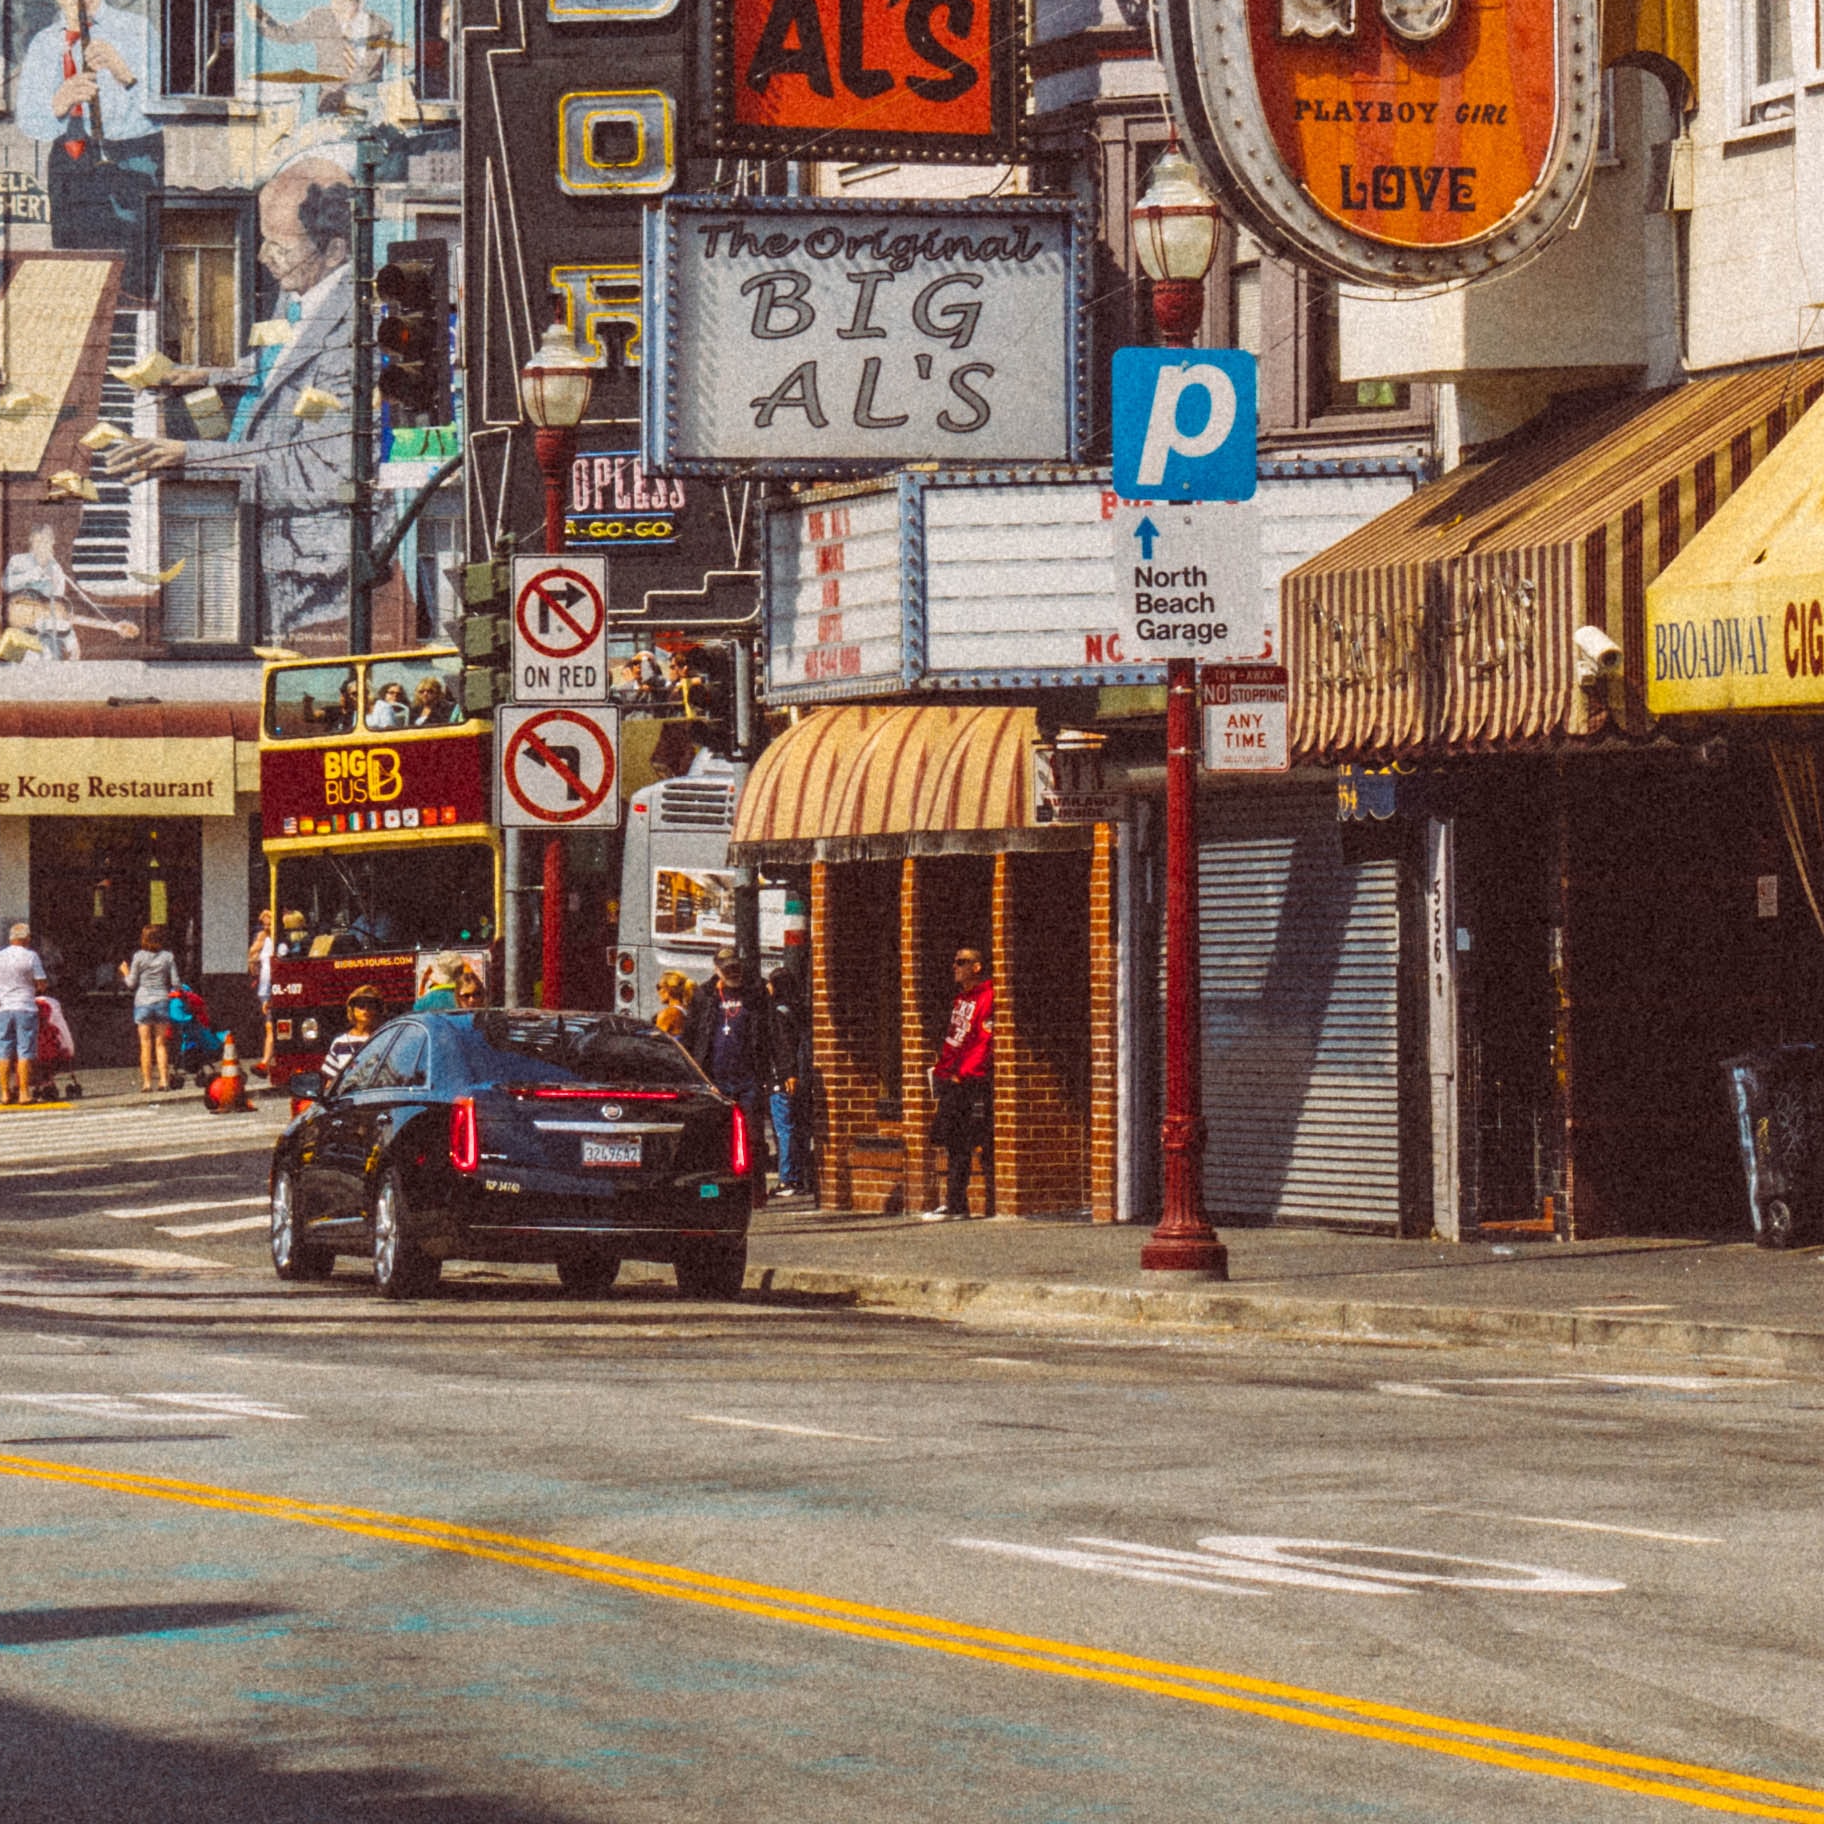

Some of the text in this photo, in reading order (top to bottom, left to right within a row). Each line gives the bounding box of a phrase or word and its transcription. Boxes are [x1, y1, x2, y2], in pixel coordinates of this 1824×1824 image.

[1294, 98, 1510, 126] PLAYBOY GIRL
[1339, 164, 1477, 213] LOVE
[698, 222, 1043, 270] The Original
[740, 269, 985, 350] BIG
[749, 354, 996, 434] AL'S
[572, 457, 686, 512] OPLESS
[1134, 565, 1208, 588] North
[1135, 591, 1215, 614] Beach
[1136, 618, 1228, 645] Garage
[1654, 614, 1772, 683] BROADWAY
[524, 665, 597, 689] ON RED
[1204, 683, 1286, 704] NO STOPPING
[1227, 713, 1264, 729] ANY
[1223, 732, 1267, 749] TIME
[324, 749, 367, 780] BIG
[16, 775, 81, 804] Kong
[87, 775, 216, 800] Restaurant
[325, 778, 368, 806] BUS
